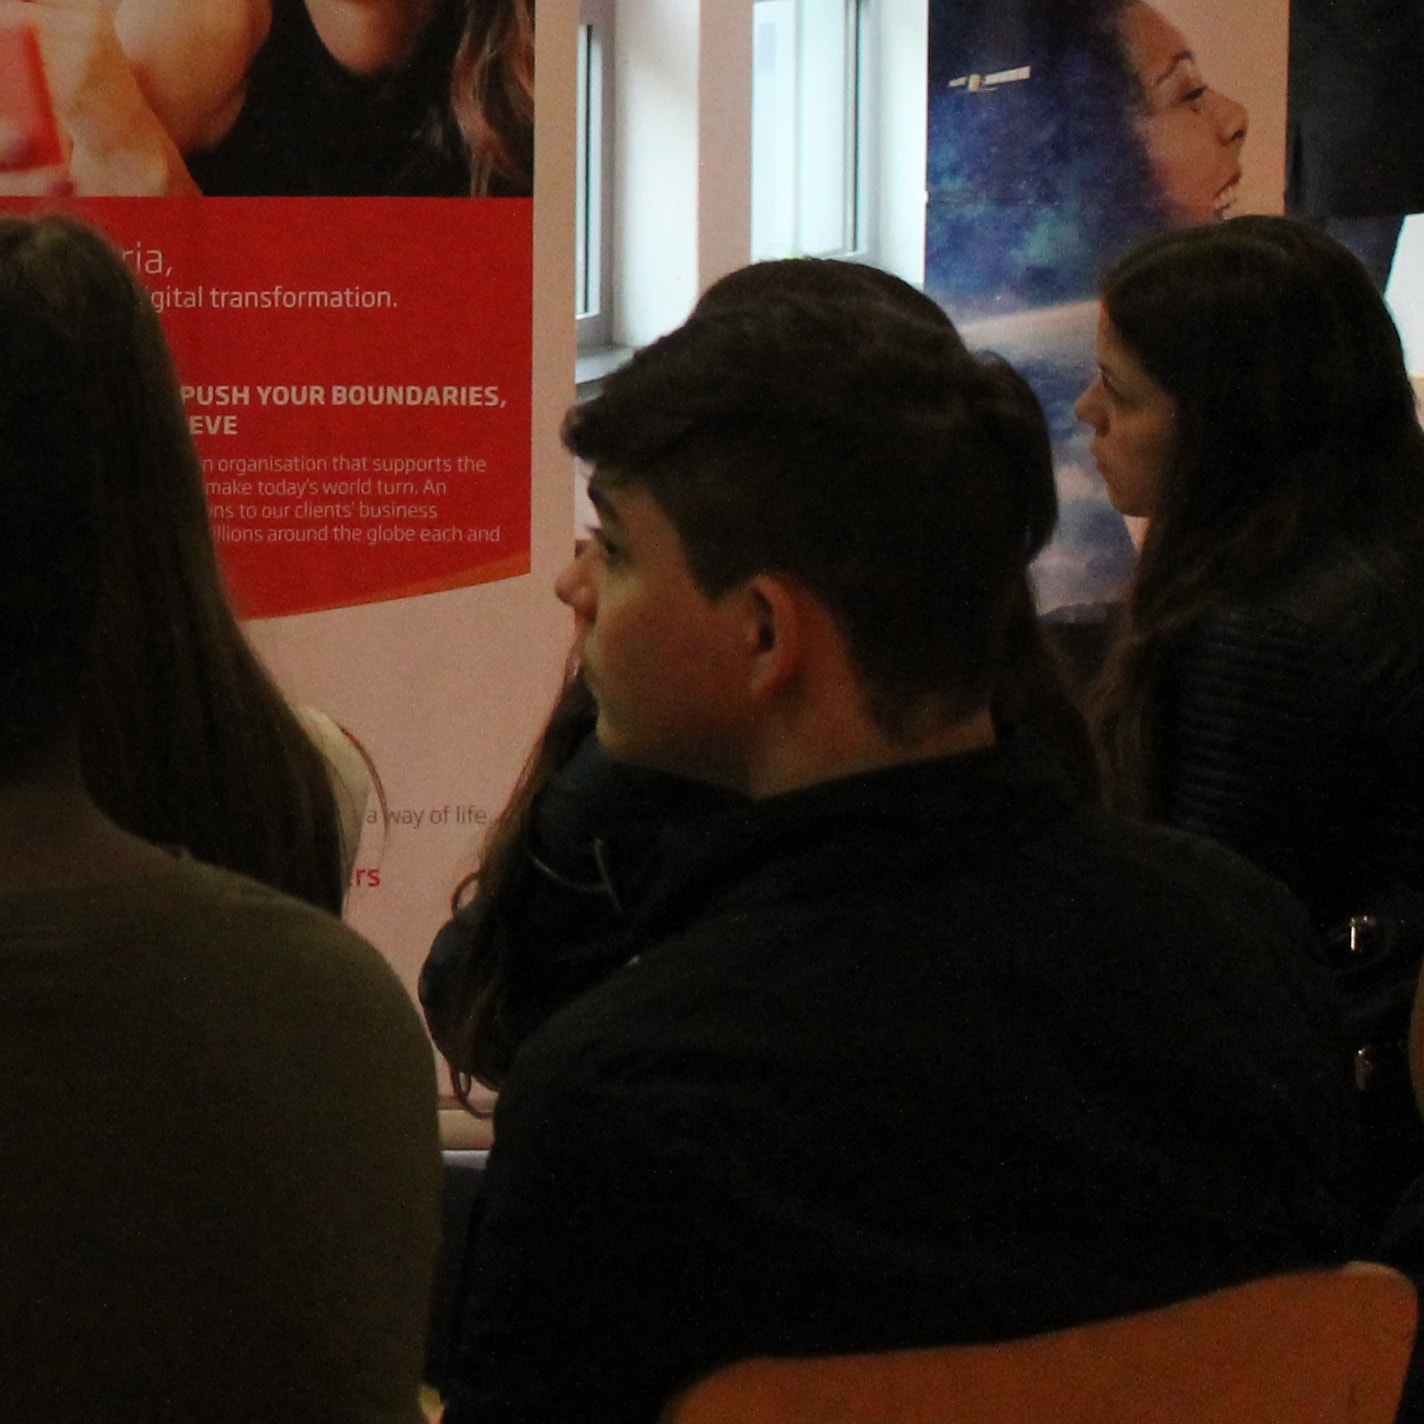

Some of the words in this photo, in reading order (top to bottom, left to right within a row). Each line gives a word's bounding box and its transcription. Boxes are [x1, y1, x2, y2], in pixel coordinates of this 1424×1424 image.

[151, 286, 203, 313] gital
[210, 286, 398, 309] transformation.
[257, 385, 325, 406] YOUR
[332, 385, 506, 410] BOUNDARIES,
[189, 416, 238, 436] EVE
[218, 456, 327, 478] organisation
[332, 456, 368, 472] that
[373, 458, 452, 478] supports
[457, 456, 487, 472] the
[207, 479, 252, 495] make
[257, 479, 318, 500] today's
[323, 479, 371, 495] world
[377, 481, 418, 495] turn.
[423, 479, 447, 495] An
[240, 503, 256, 518] to
[261, 505, 289, 518] our
[295, 502, 355, 518] clients'
[359, 502, 438, 518] business
[216, 526, 263, 542] llions
[267, 526, 328, 542] around
[333, 526, 361, 542] the
[366, 526, 415, 546] globe
[420, 526, 463, 542] each
[467, 526, 501, 542] and
[367, 810, 378, 824] a
[430, 805, 451, 824] of
